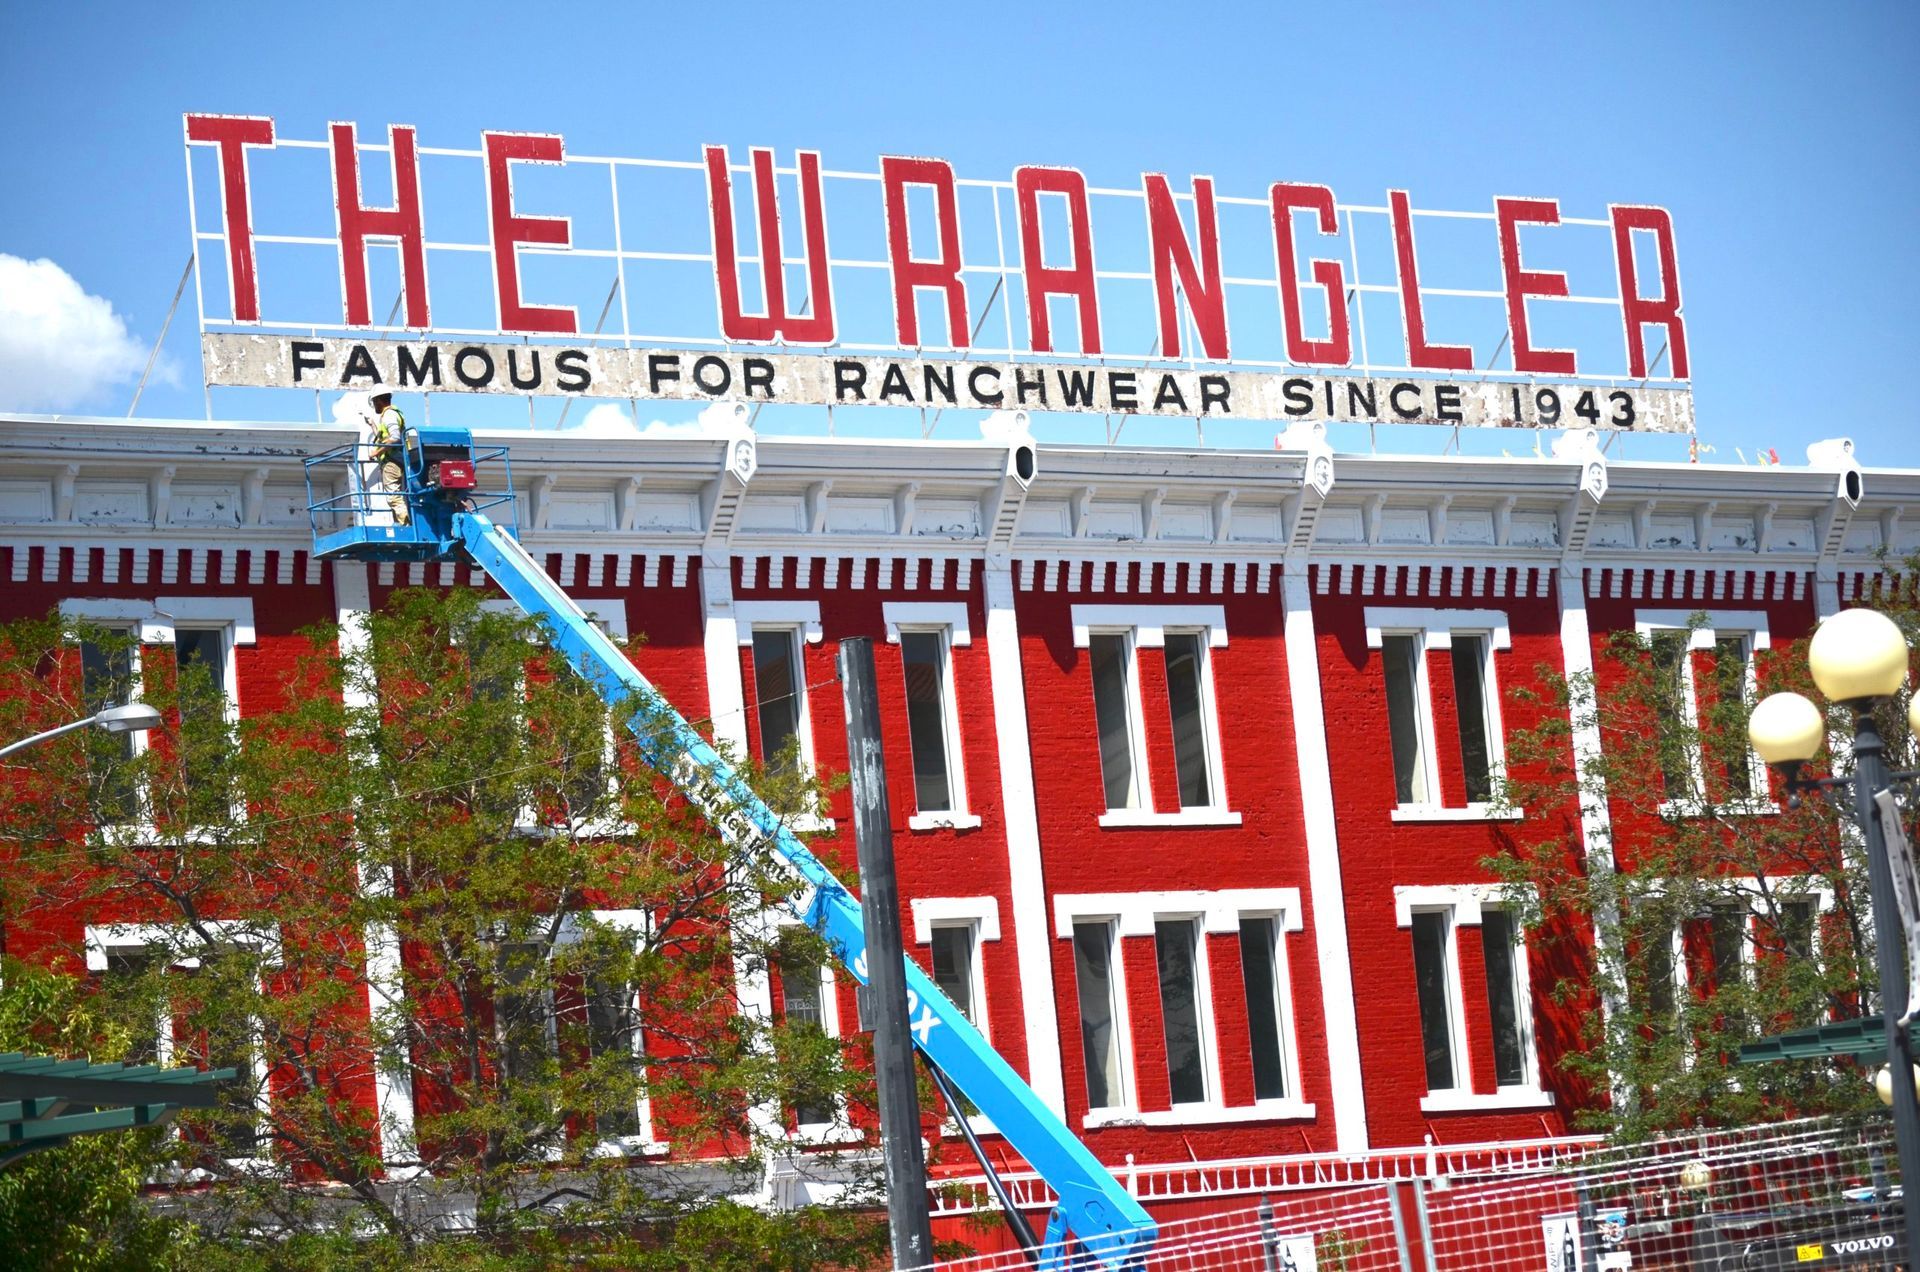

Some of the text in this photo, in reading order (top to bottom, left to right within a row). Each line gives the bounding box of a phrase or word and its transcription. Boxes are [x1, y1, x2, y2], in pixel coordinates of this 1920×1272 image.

[183, 113, 1690, 381] THE WRANGLER
[291, 341, 1636, 427] FAMOUS FOR RANCHWEAR SINCE 1943
[700, 783, 752, 840] Unted
[1831, 1235, 1894, 1254] VOLVO
